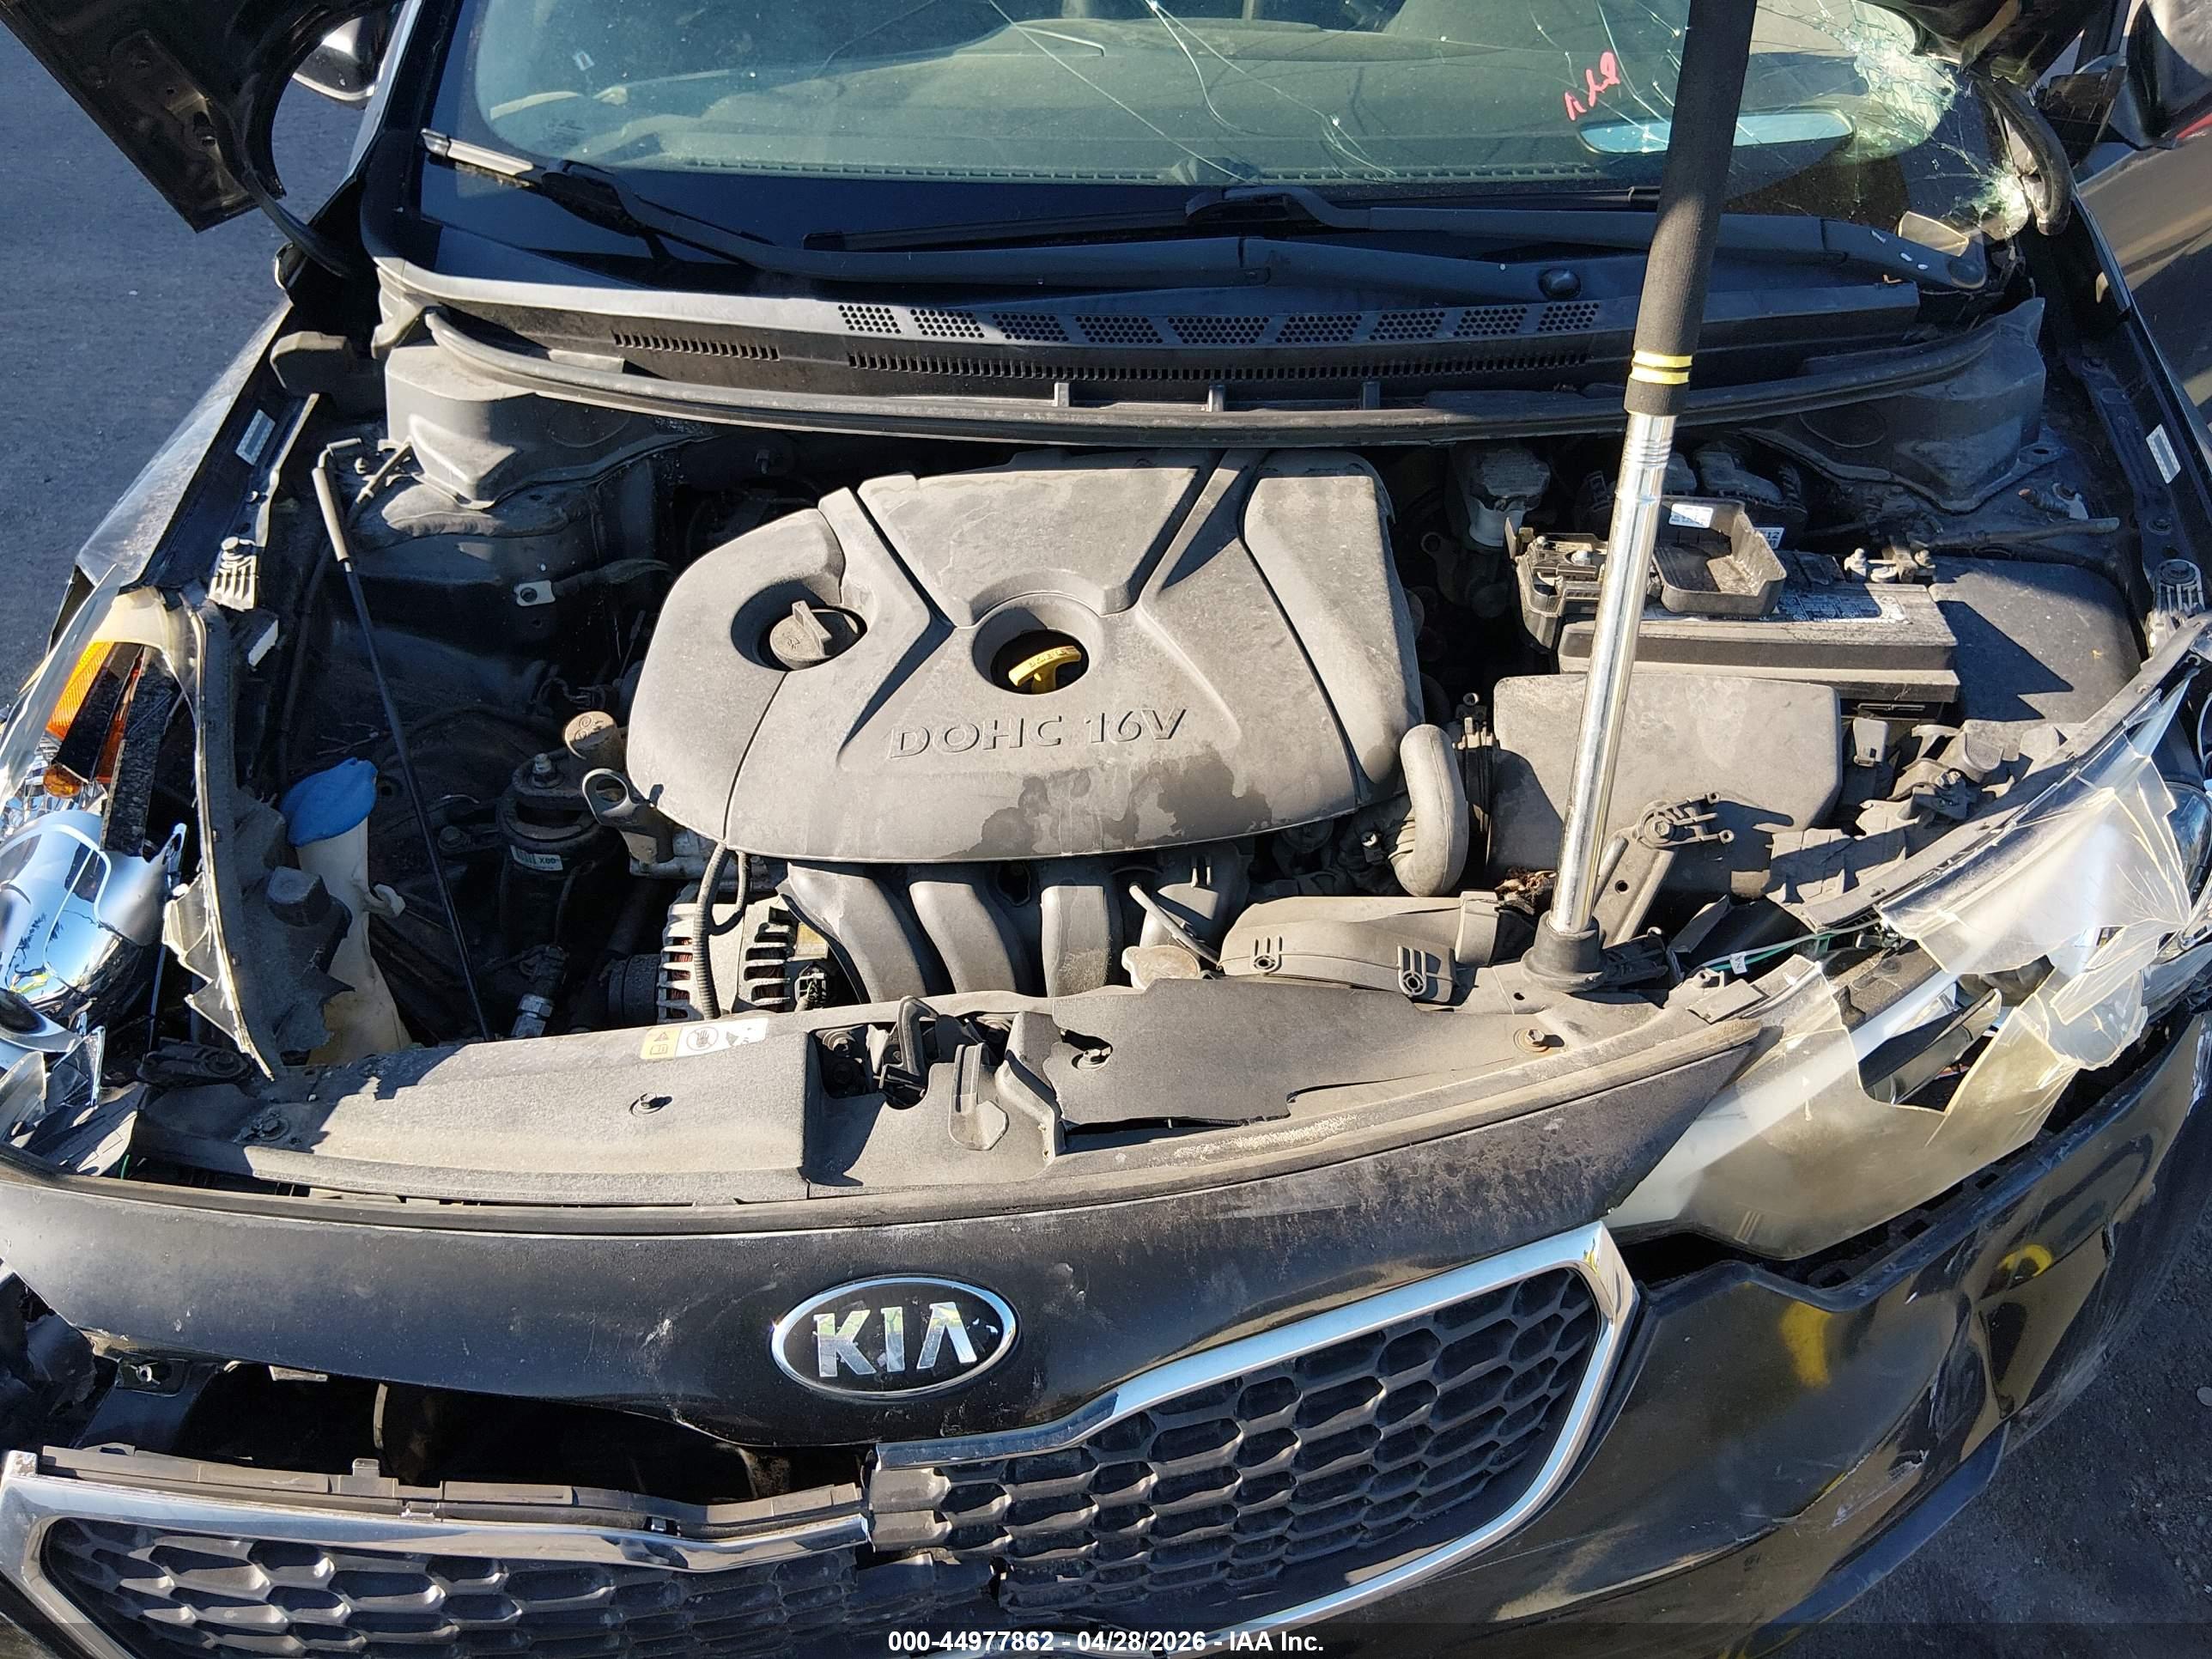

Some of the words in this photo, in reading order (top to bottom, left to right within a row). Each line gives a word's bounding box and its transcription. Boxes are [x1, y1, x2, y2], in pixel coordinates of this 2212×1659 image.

[888, 714, 1063, 760] DOHC
[1085, 708, 1188, 745] 16V
[813, 1301, 978, 1378] KIA
